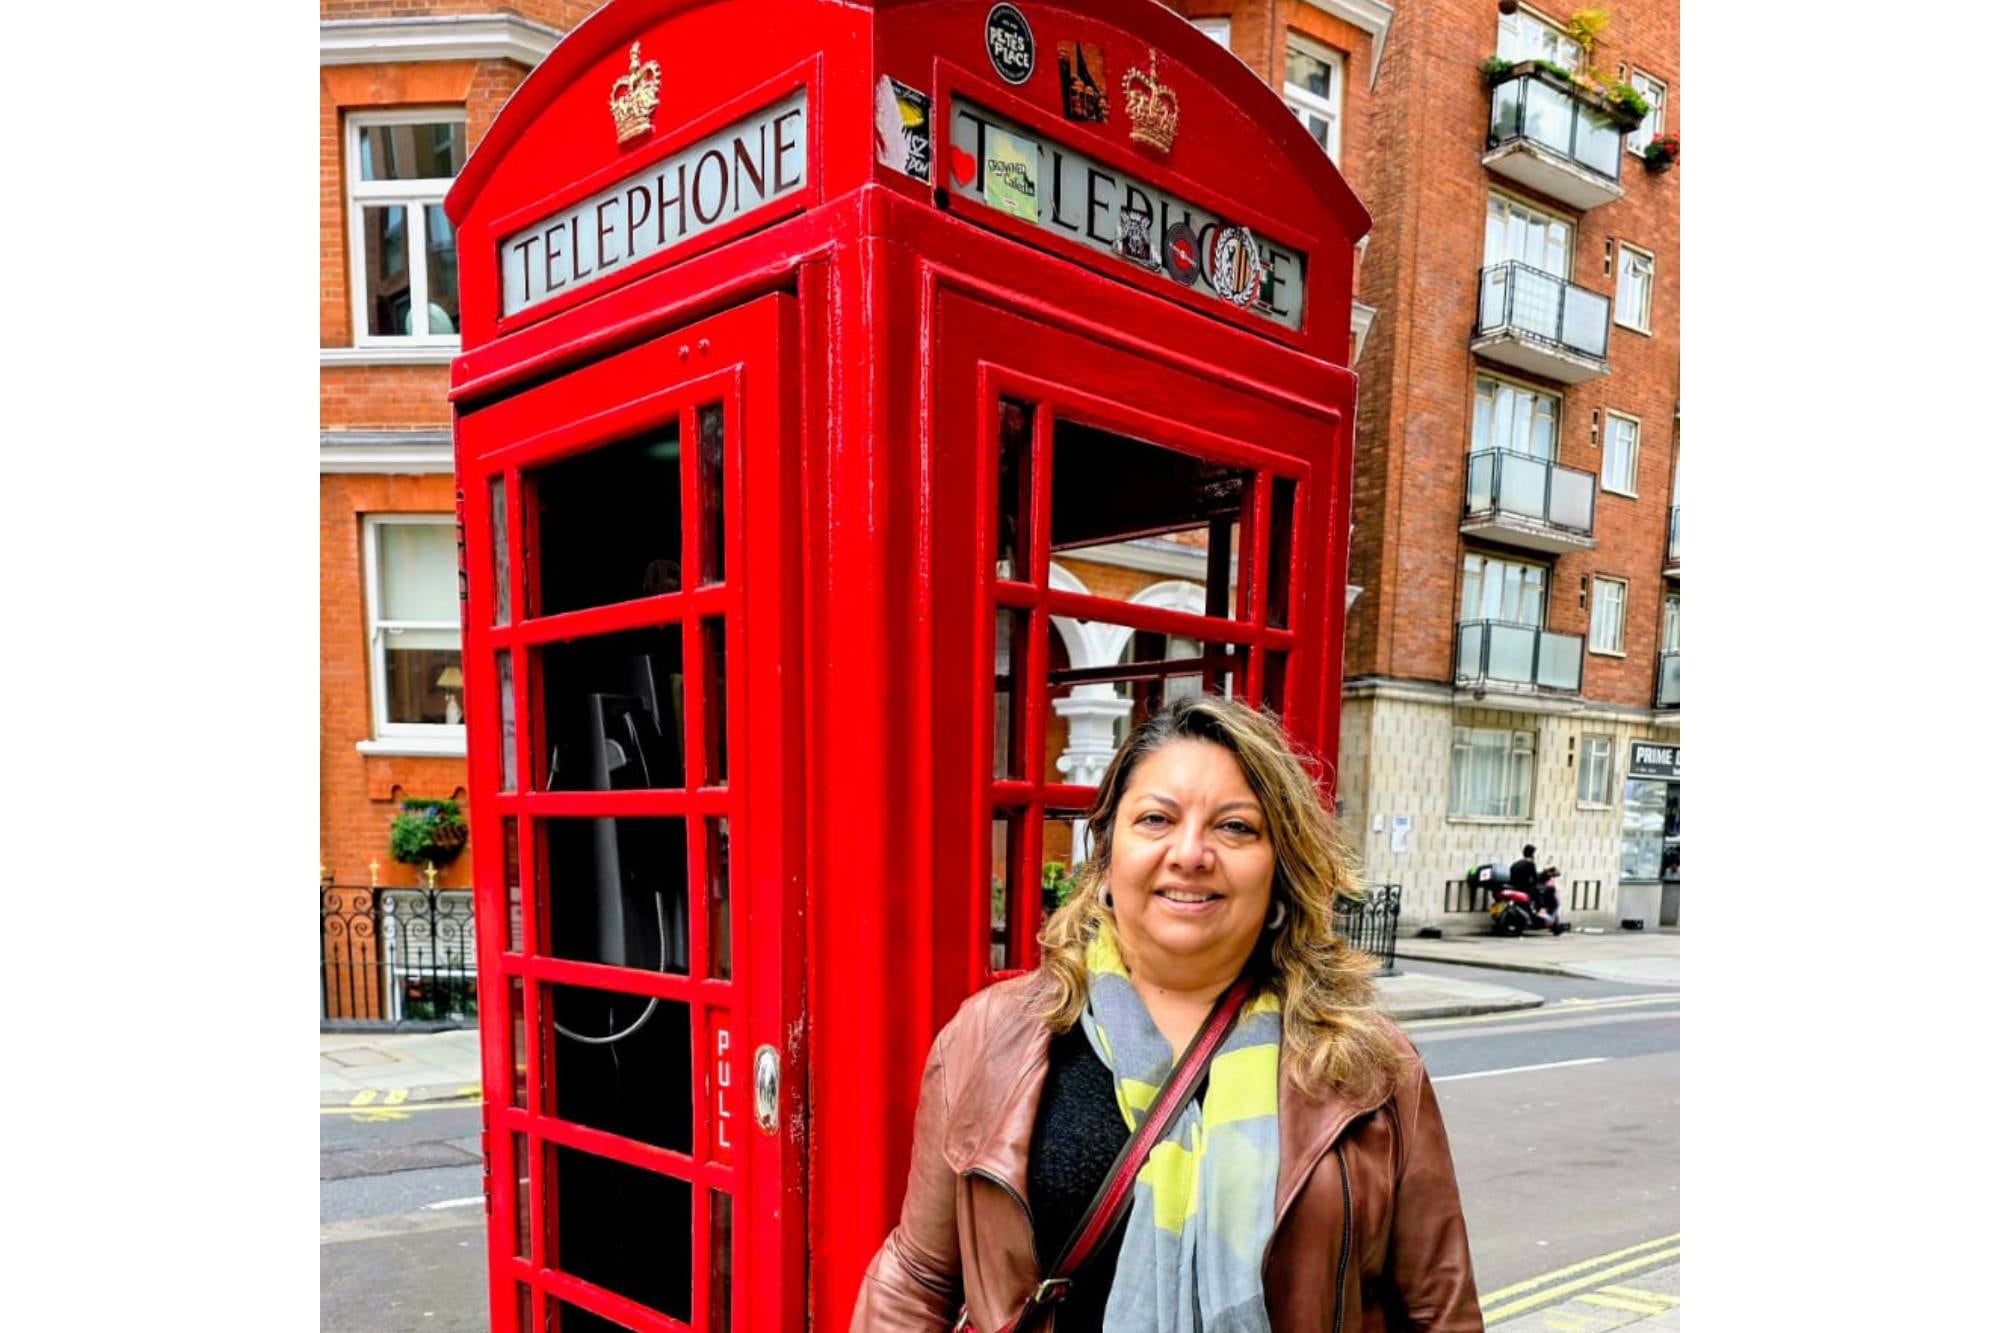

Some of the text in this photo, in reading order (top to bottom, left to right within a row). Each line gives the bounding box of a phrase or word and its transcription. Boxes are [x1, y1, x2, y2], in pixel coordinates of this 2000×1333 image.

[990, 26, 1025, 52] PETE'S
[995, 42, 1030, 69] PLACE
[513, 108, 801, 302] TELEPHONE
[1635, 746, 1673, 765] PRIME
[718, 1029, 731, 1147] PULL
